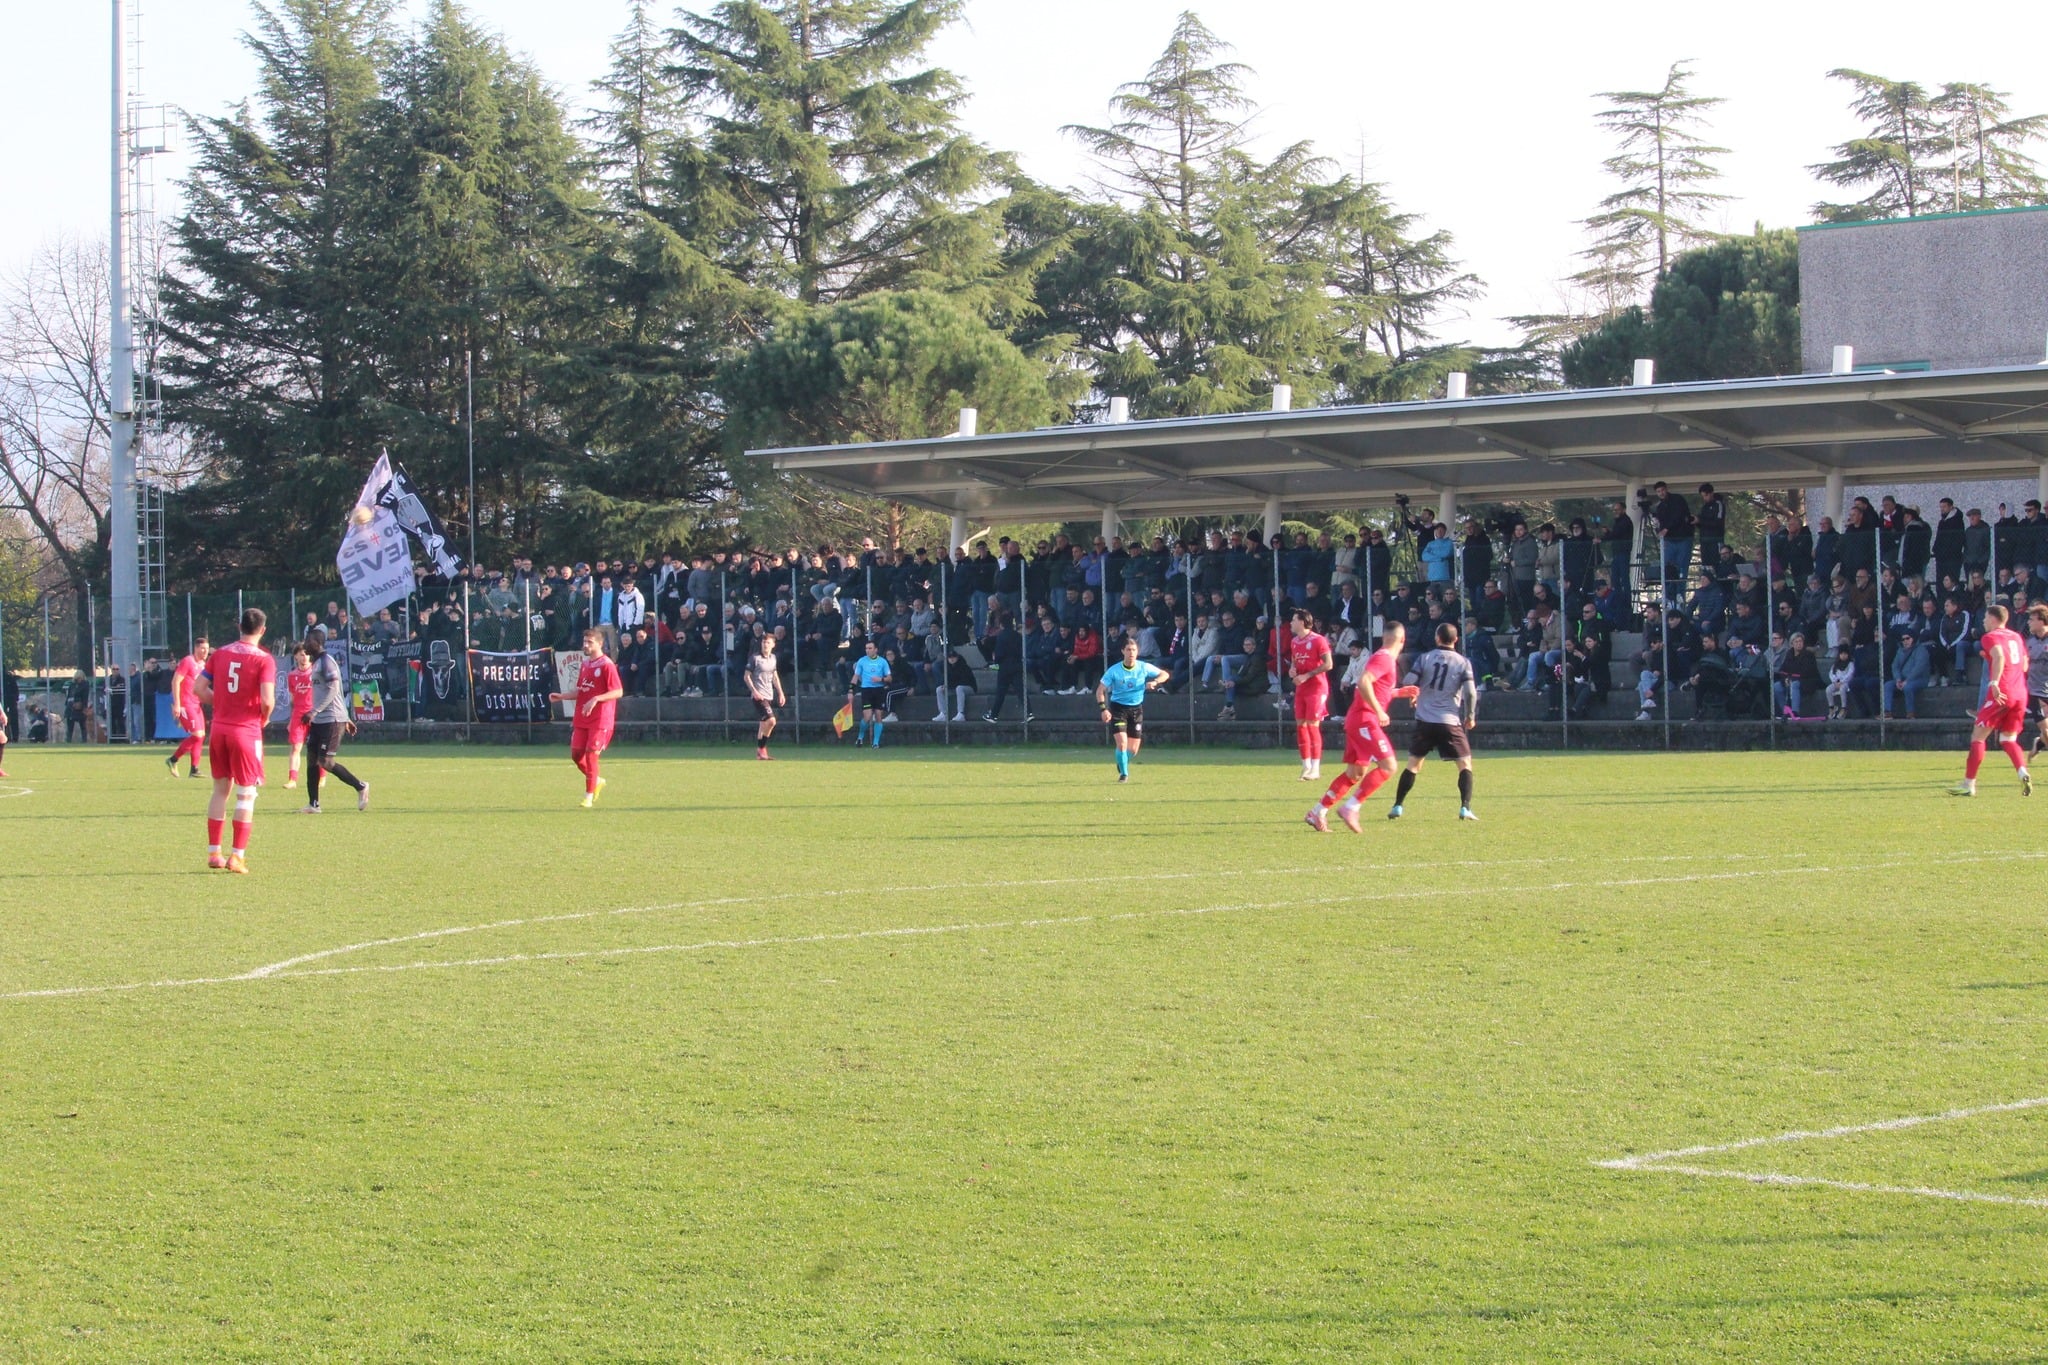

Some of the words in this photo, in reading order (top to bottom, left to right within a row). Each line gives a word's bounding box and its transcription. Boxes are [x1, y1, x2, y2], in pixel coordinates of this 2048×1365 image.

[2008, 639, 2020, 665] 8
[227, 662, 242, 694] 5
[483, 664, 540, 682] PRESENZE
[1429, 662, 1449, 691] 11
[485, 693, 545, 710] DISTANTI
